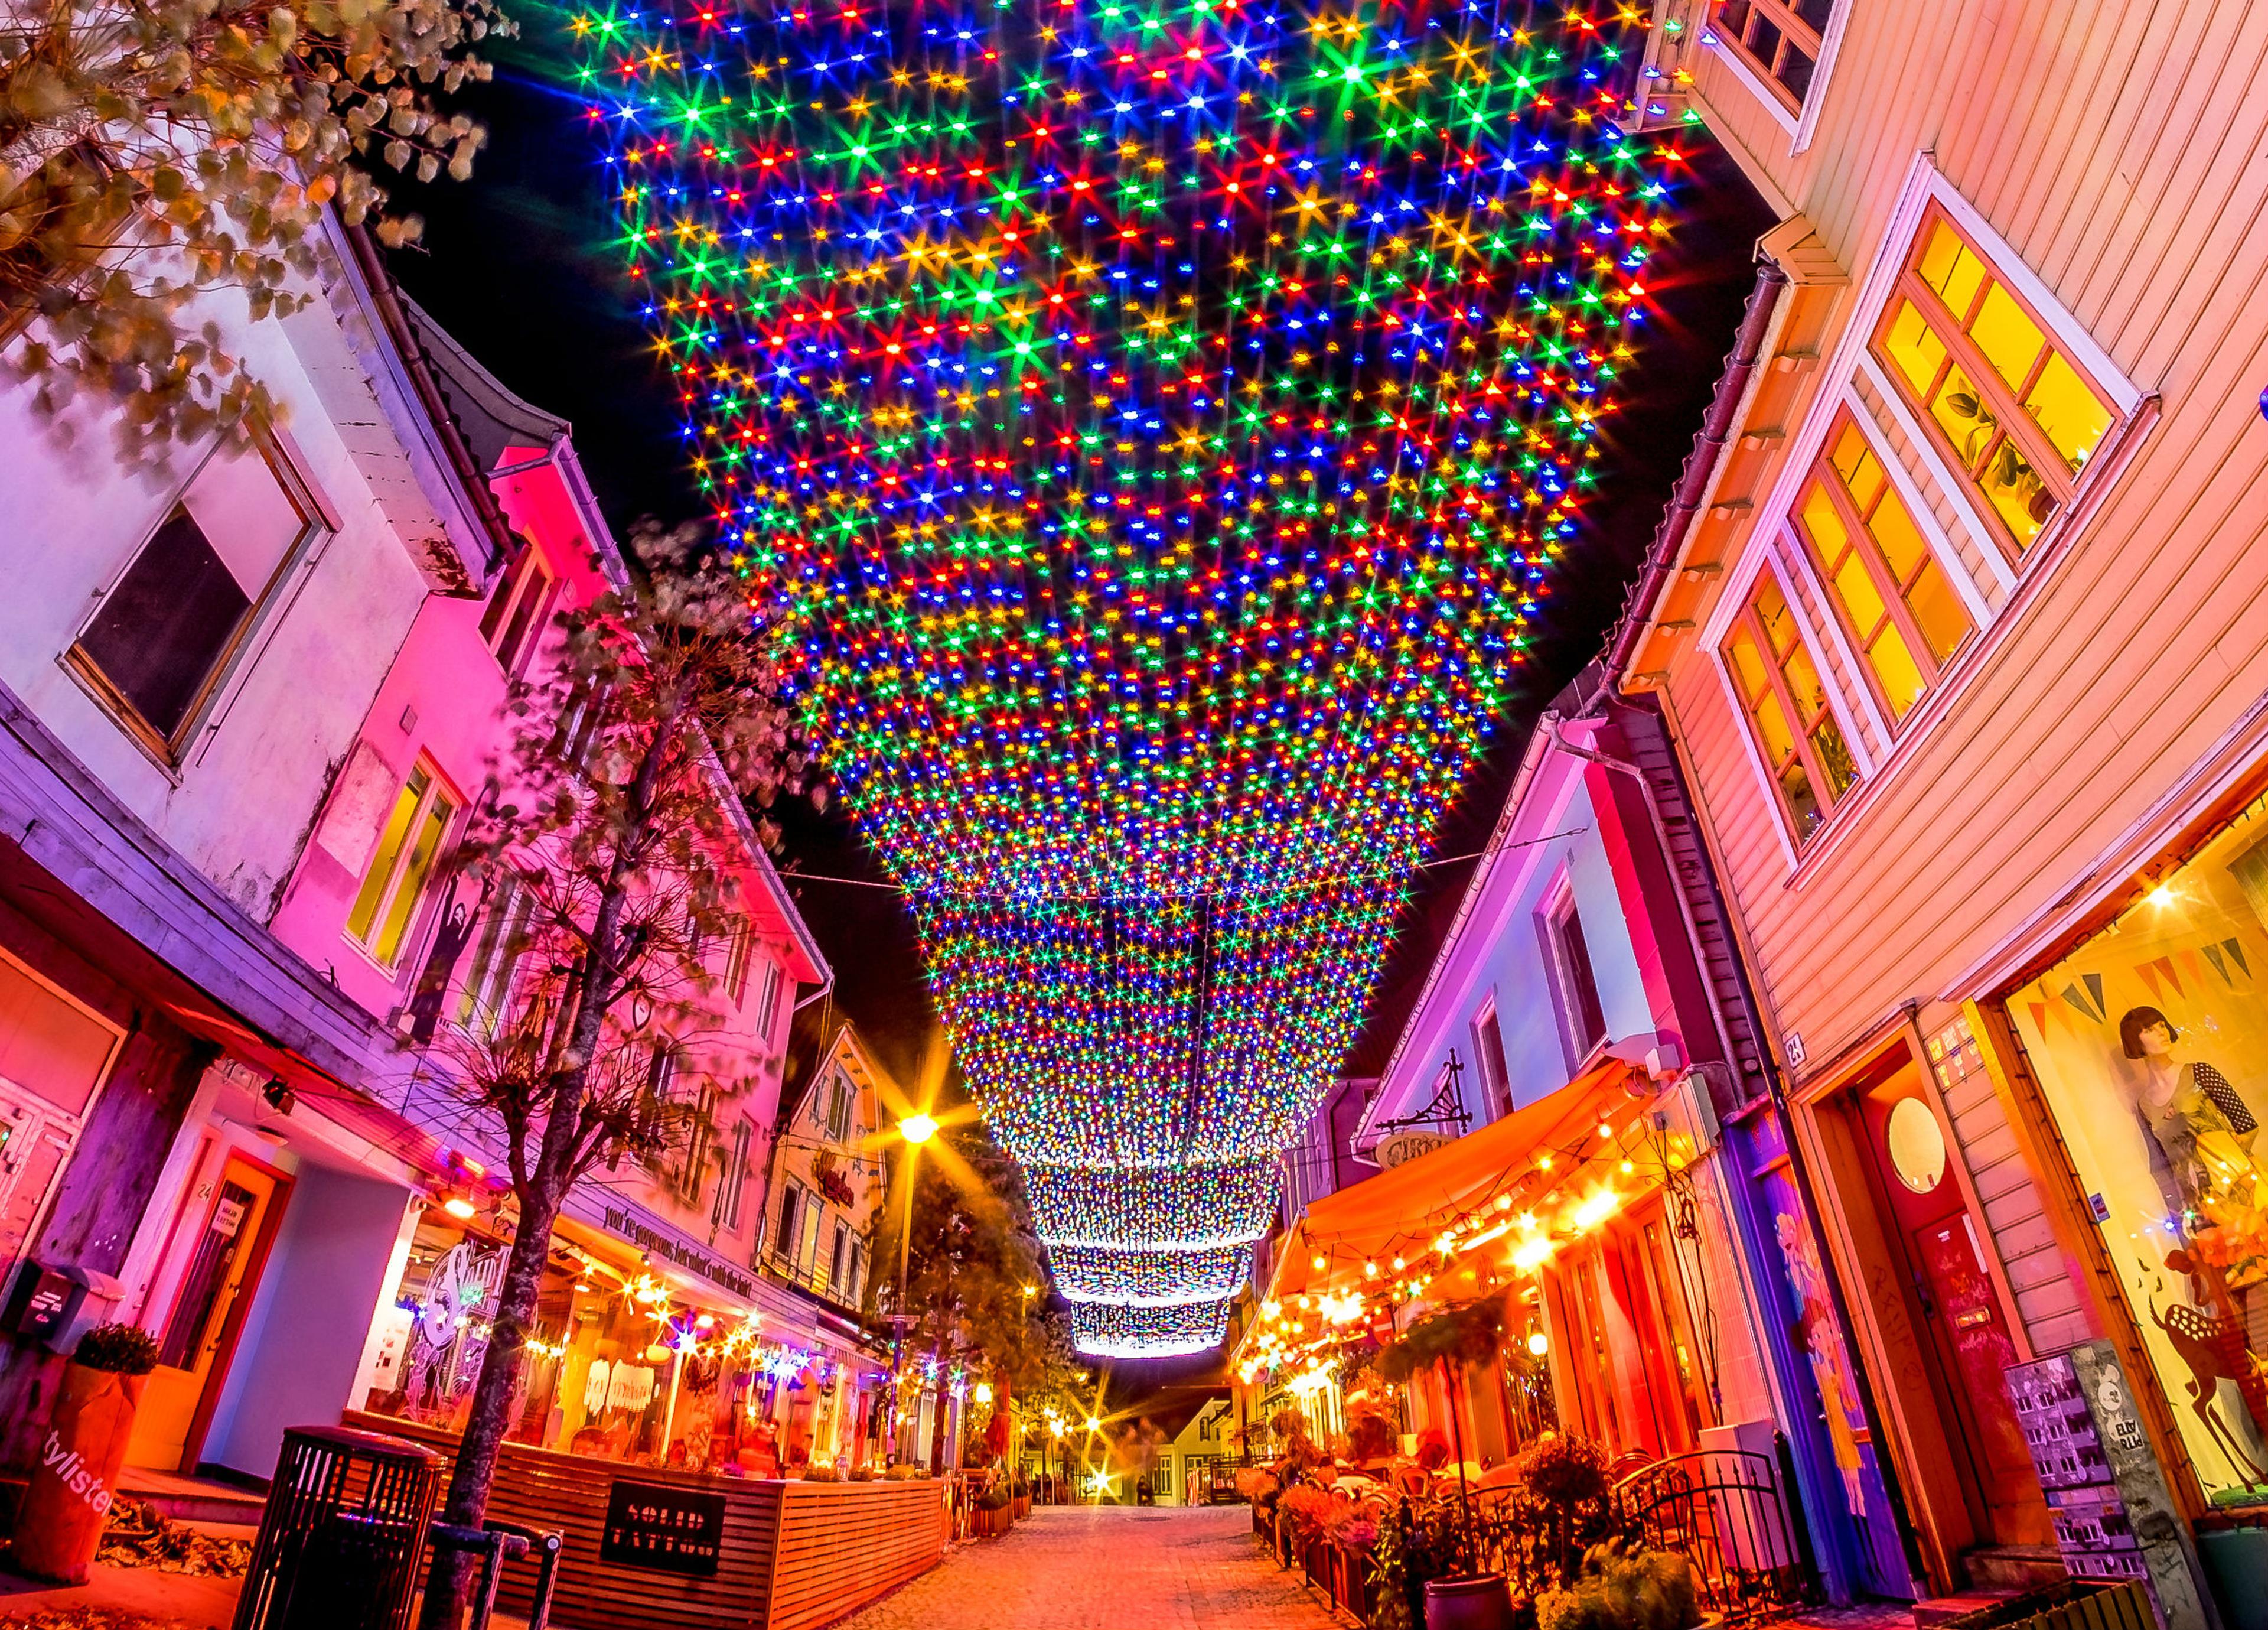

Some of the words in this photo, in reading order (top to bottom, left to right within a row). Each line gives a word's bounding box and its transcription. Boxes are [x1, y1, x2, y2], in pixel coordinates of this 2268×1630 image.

[1387, 1136, 1448, 1168] CIRK
[198, 1183, 211, 1199] 24
[603, 1206, 636, 1238] you're
[634, 1224, 674, 1261] gorgeous,
[674, 1239, 689, 1267] but
[627, 1504, 704, 1529] SOLID
[611, 1527, 713, 1556] TATTOO
